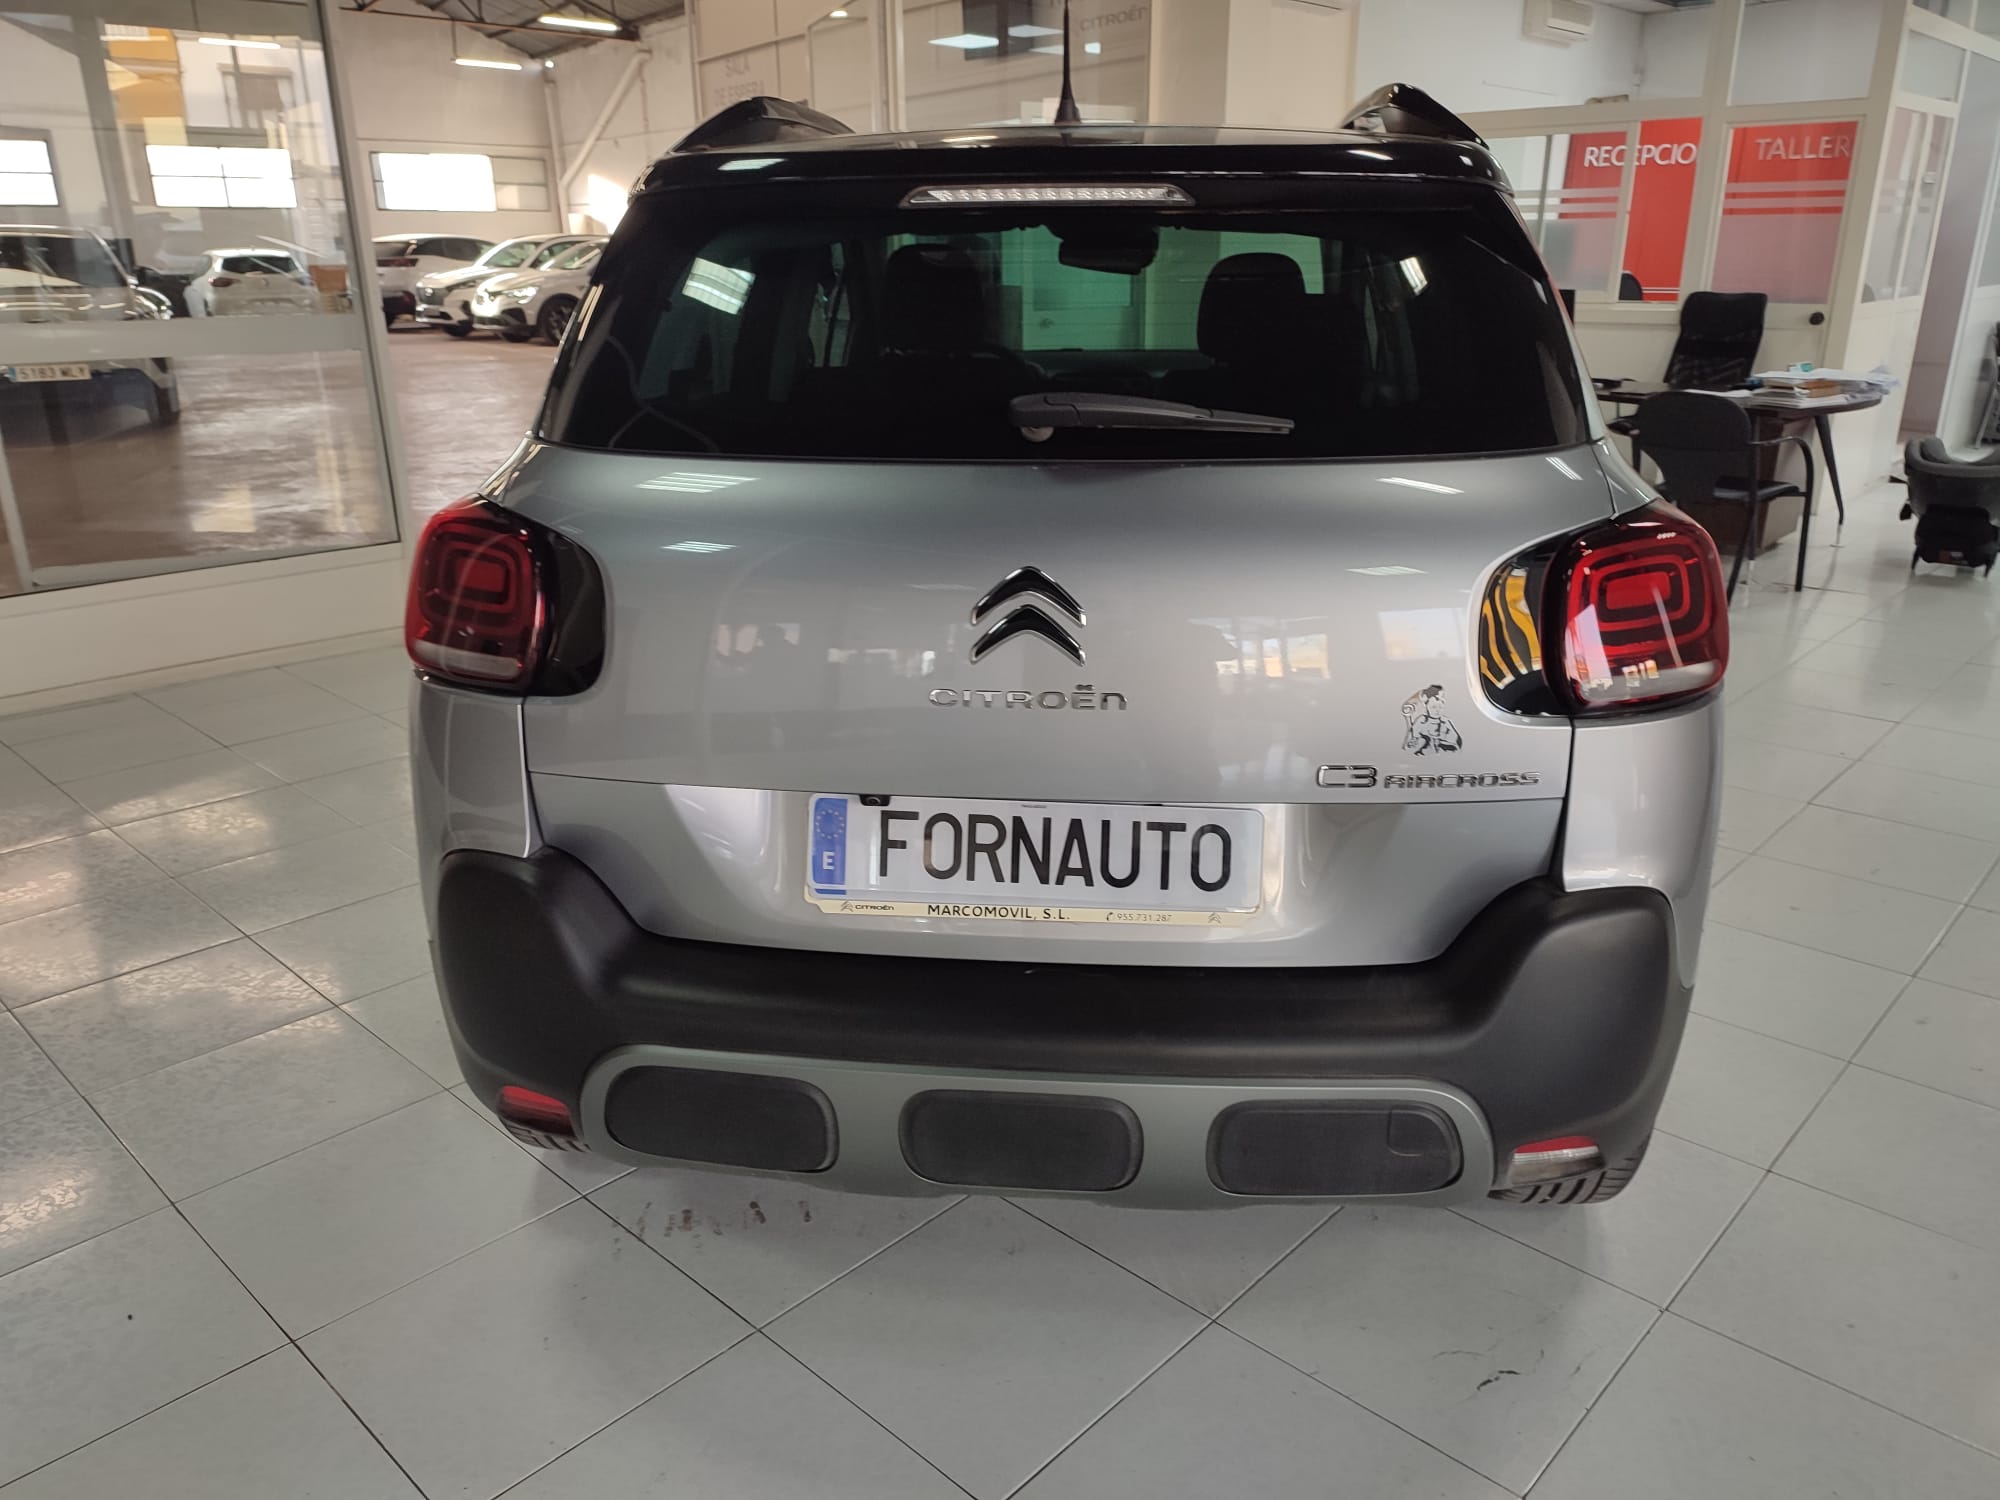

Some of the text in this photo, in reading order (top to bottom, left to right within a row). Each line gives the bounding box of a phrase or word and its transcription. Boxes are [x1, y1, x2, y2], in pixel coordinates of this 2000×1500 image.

[1755, 136, 1850, 161] TALLER
[1316, 765, 1541, 789] C3 AIRCROSS
[822, 851, 835, 870] E
[879, 810, 1232, 892] FORNAUTO
[1043, 908, 1071, 920] S.L.
